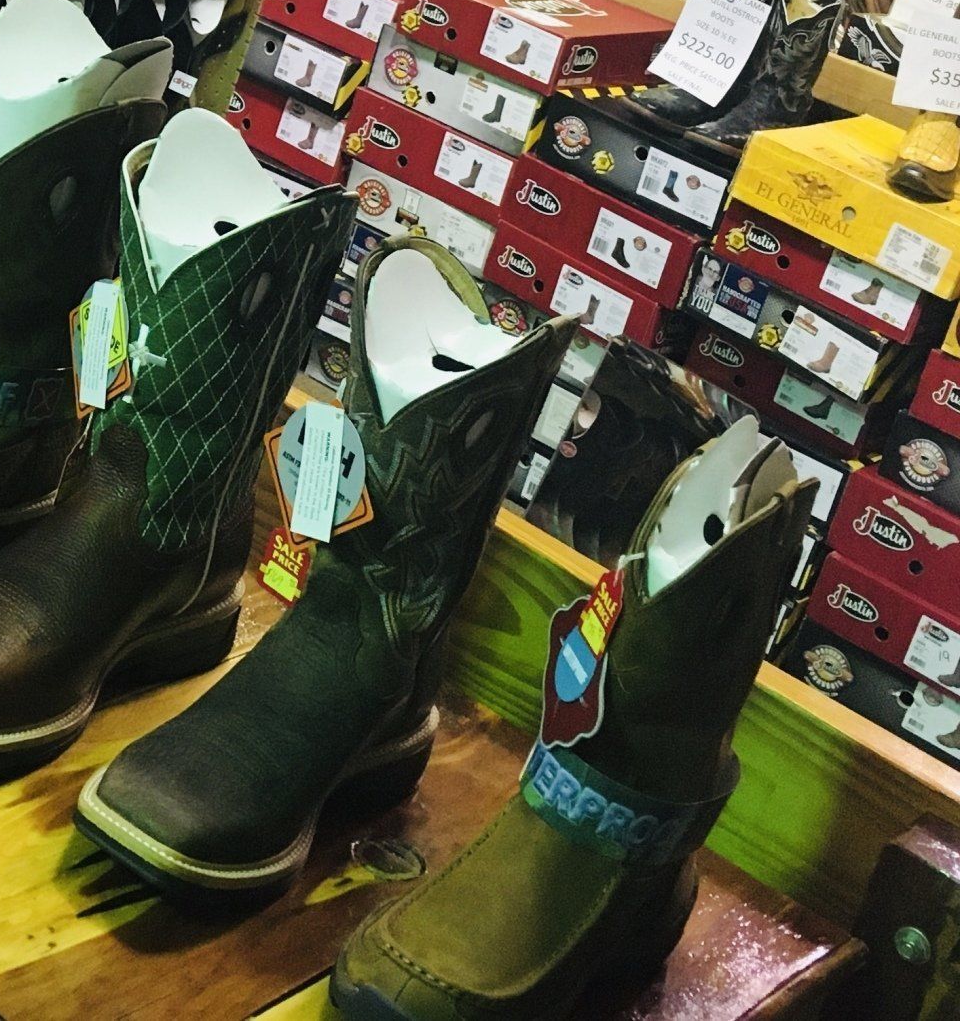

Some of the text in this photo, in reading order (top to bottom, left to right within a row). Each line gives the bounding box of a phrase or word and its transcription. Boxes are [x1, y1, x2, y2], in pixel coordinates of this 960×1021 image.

[711, 10, 735, 27] BOOTS
[731, 6, 763, 26] OSTRICH
[696, 19, 711, 32] SIZE
[712, 27, 721, 36] 10
[728, 35, 738, 46] EE
[920, 29, 959, 45] GENERAL
[562, 45, 598, 75] Justin
[678, 32, 735, 71] $225.00
[680, 60, 698, 75] PRICE
[935, 97, 956, 109] SALE
[358, 115, 400, 149] Justin
[516, 178, 561, 215] Justin
[755, 181, 852, 239] EL GENERAL
[740, 219, 781, 254] Justin
[497, 245, 536, 277] Justin
[691, 294, 712, 313] YOU
[699, 333, 744, 367] Justin
[853, 506, 913, 551] Justin
[272, 550, 300, 576] PRICE
[273, 535, 305, 567] SALE
[593, 597, 611, 627] PRICE
[600, 582, 618, 617] SALE
[827, 583, 879, 622] Justin
